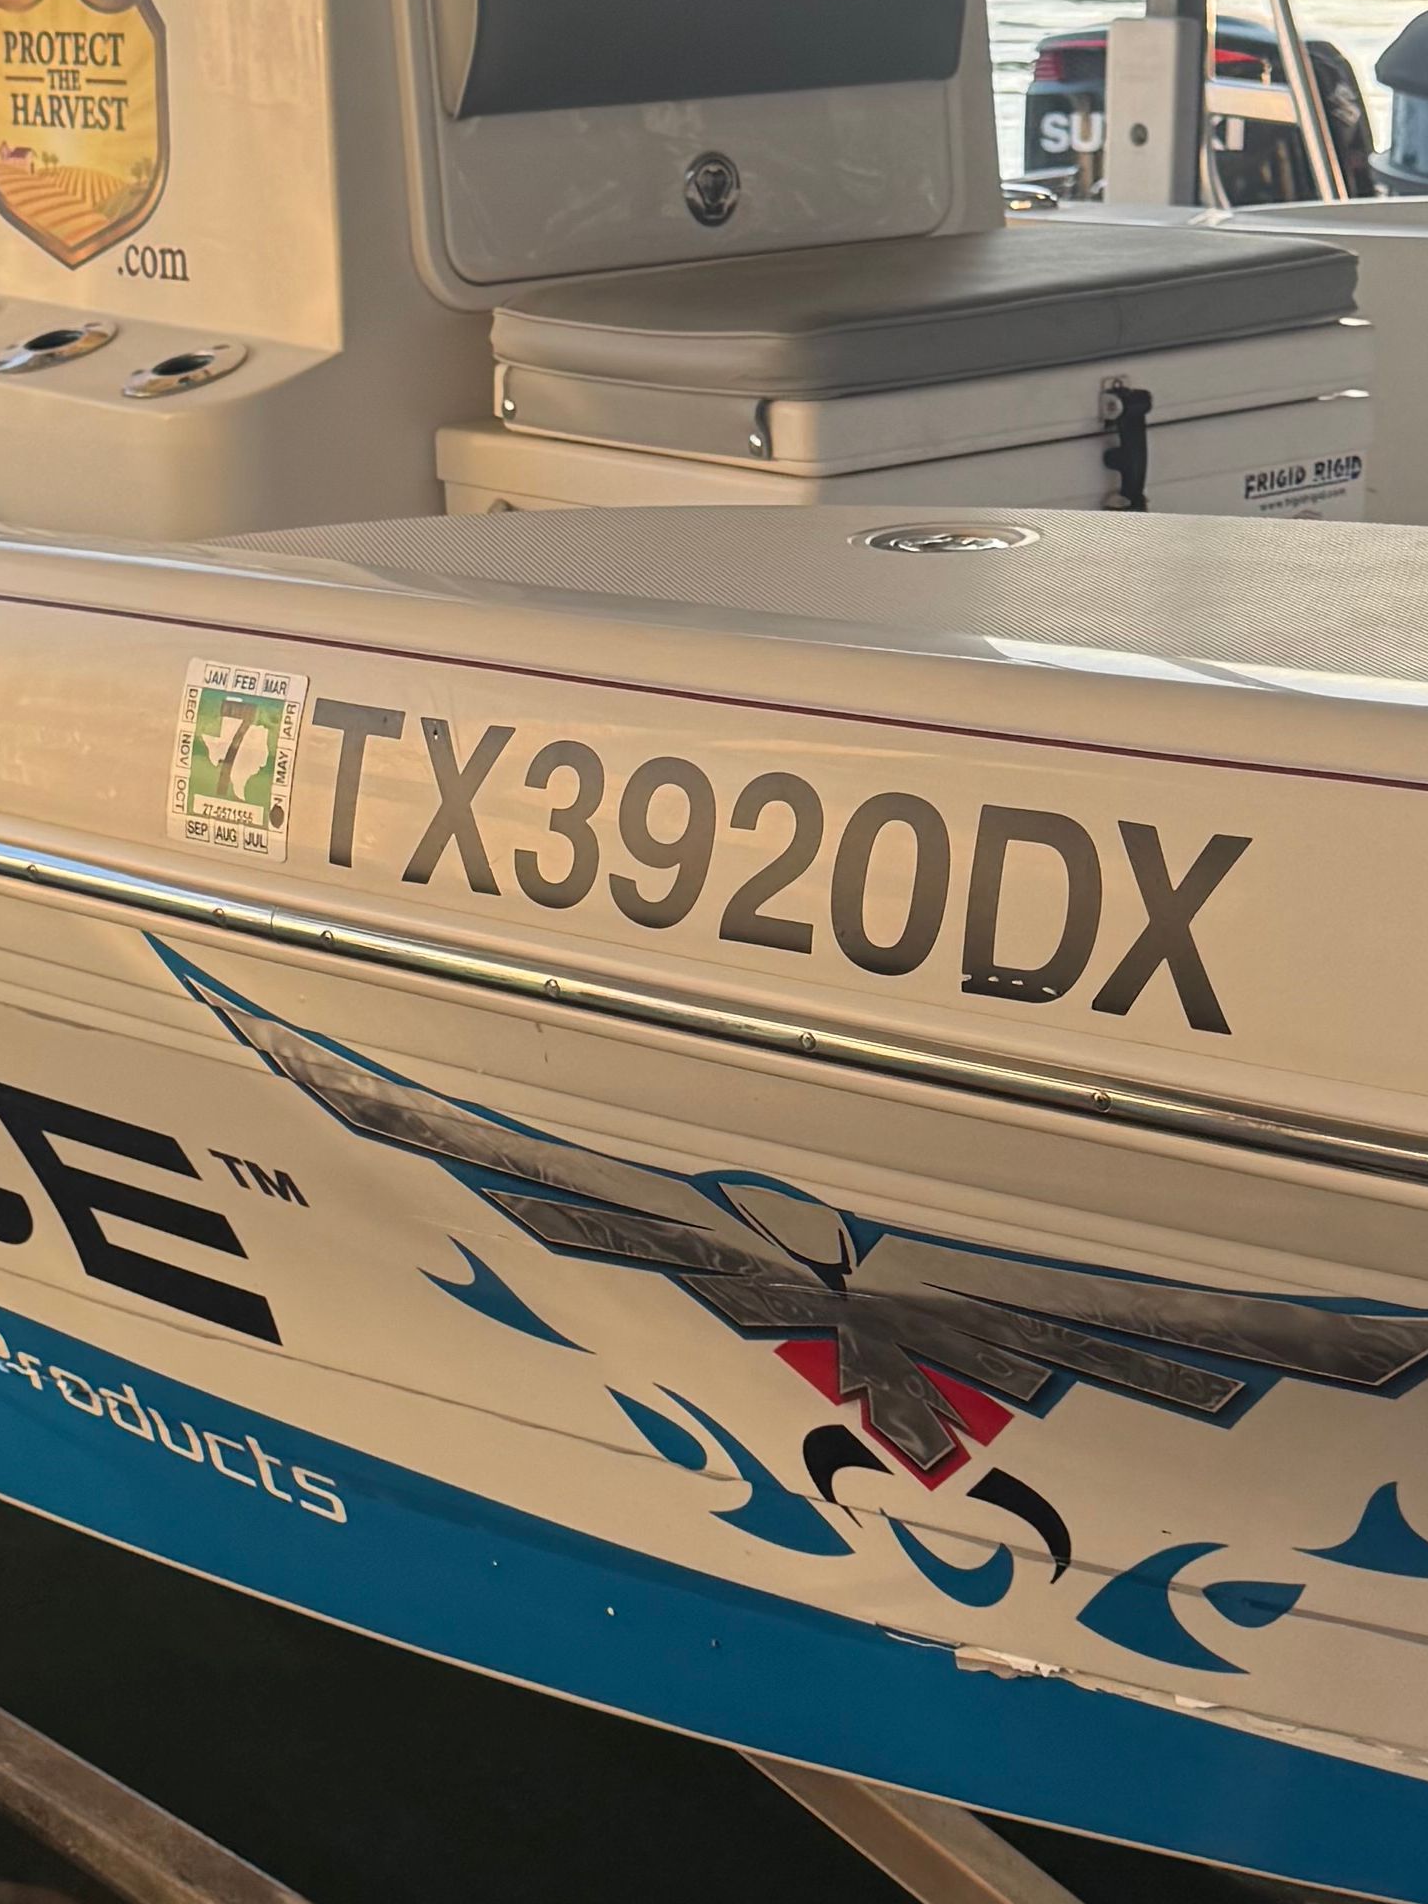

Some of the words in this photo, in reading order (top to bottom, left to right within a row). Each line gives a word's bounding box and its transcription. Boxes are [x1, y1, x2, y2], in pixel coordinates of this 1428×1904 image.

[3, 30, 125, 67] PROTECT
[47, 69, 81, 91] THE
[10, 93, 129, 131] HARVEST
[117, 244, 189, 281] .com
[1244, 465, 1307, 500] FRIGID
[1312, 455, 1362, 482] RIGID
[204, 670, 228, 686] JAN
[233, 674, 257, 690] FEB
[263, 679, 288, 696] MAR
[185, 688, 199, 722] DEC
[284, 702, 298, 739] APR
[180, 733, 193, 766] NOV
[275, 750, 290, 784] MAY
[175, 779, 188, 812] OCT
[187, 820, 209, 837] SEP
[215, 826, 238, 843] AUG
[242, 832, 268, 849] JUL
[310, 697, 1253, 1036] TX3920DX
